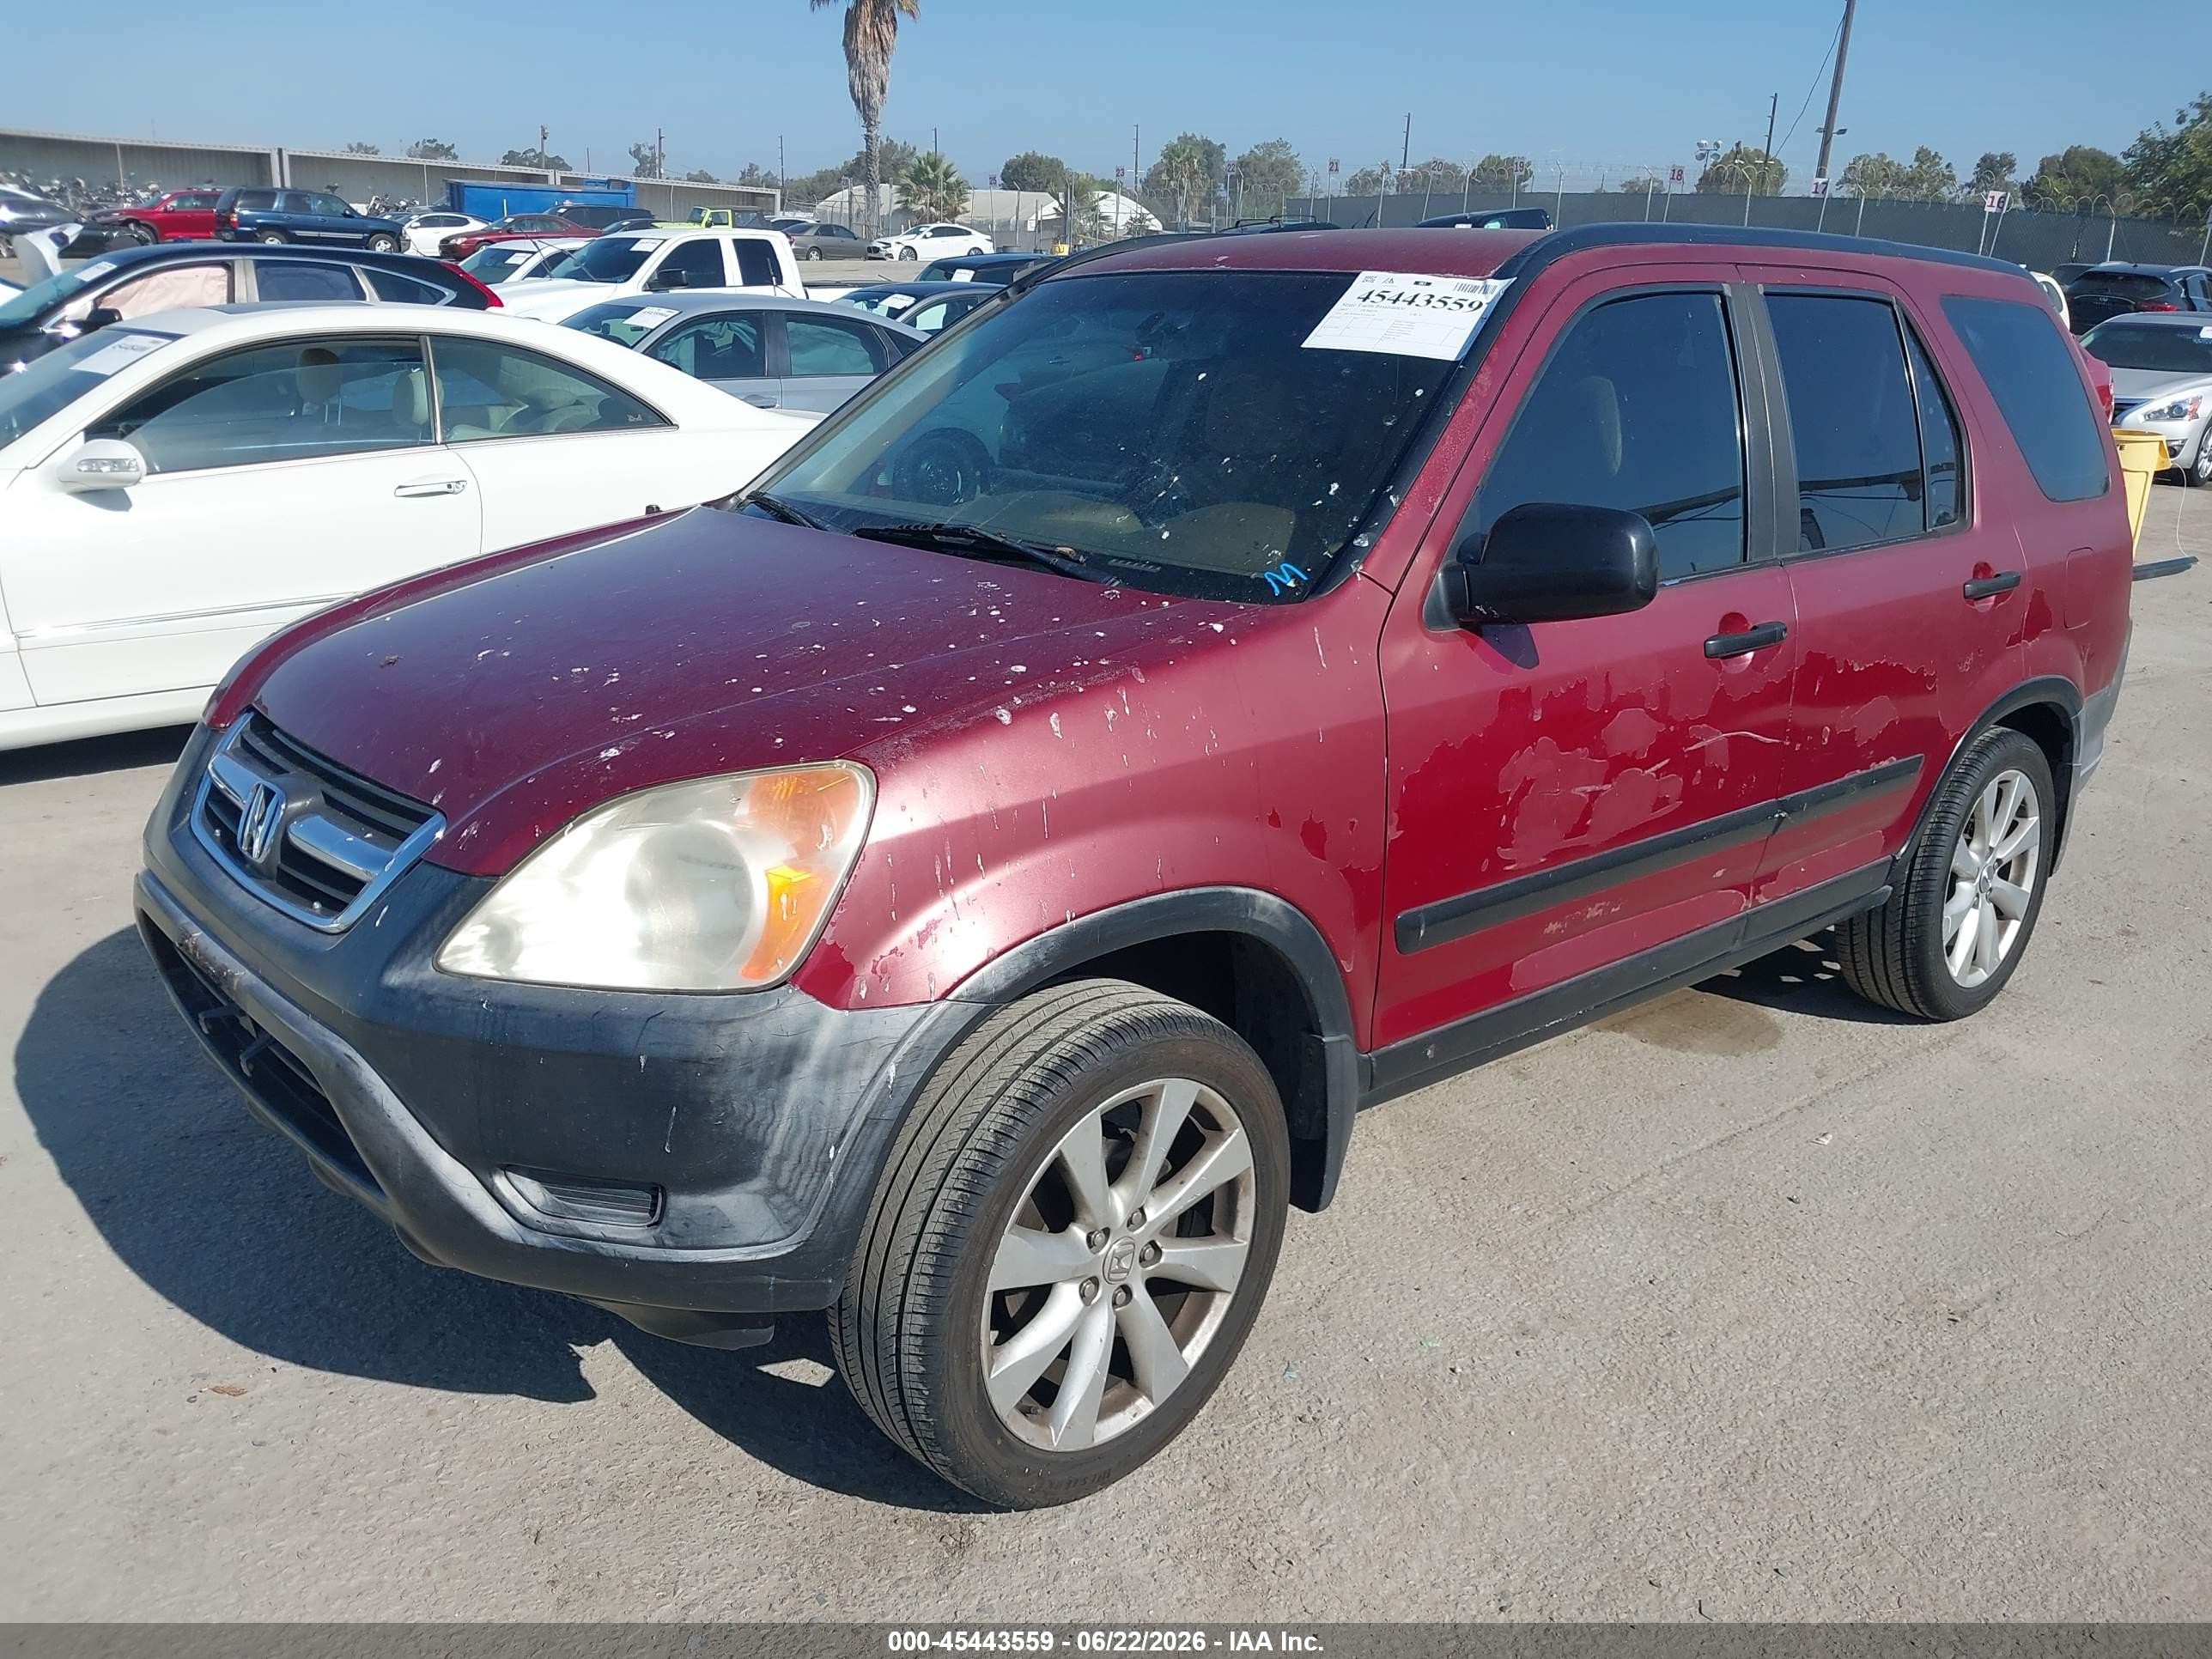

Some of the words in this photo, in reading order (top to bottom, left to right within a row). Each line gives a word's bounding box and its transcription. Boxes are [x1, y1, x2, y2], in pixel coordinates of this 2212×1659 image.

[1227, 163, 1236, 173] 22
[1328, 161, 1340, 173] 21
[1431, 161, 1443, 172] 20
[1514, 161, 1525, 173] 19
[1115, 168, 1125, 178] 23
[1669, 169, 1684, 181] 18
[989, 177, 997, 185] 25
[1812, 181, 1828, 194] 17
[1987, 195, 2005, 210] 16
[1357, 289, 1485, 313] 45443559
